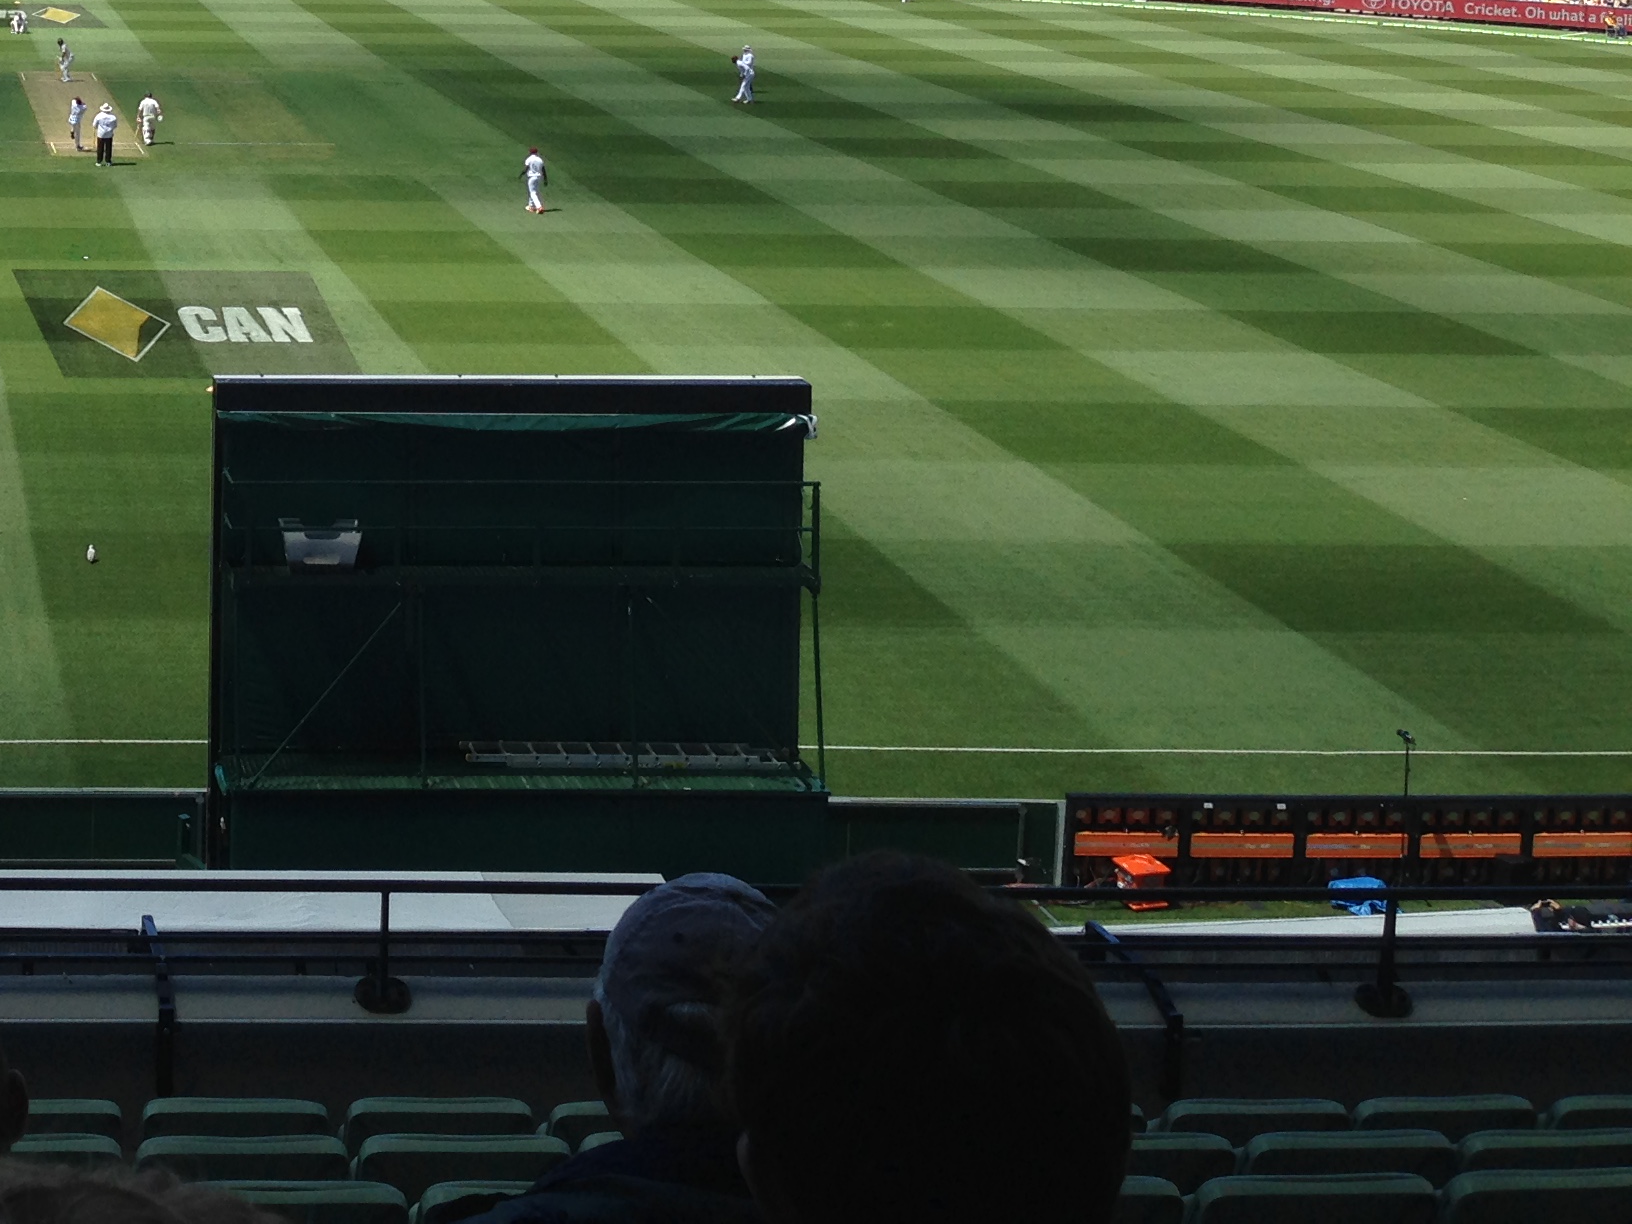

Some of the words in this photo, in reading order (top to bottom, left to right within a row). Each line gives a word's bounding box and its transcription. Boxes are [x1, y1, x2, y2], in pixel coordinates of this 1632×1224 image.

[1464, 3, 1521, 18] Cricket.
[1525, 7, 1545, 20] Oh
[1549, 9, 1585, 23] what
[1588, 13, 1597, 23] a
[177, 306, 314, 343] CAN
